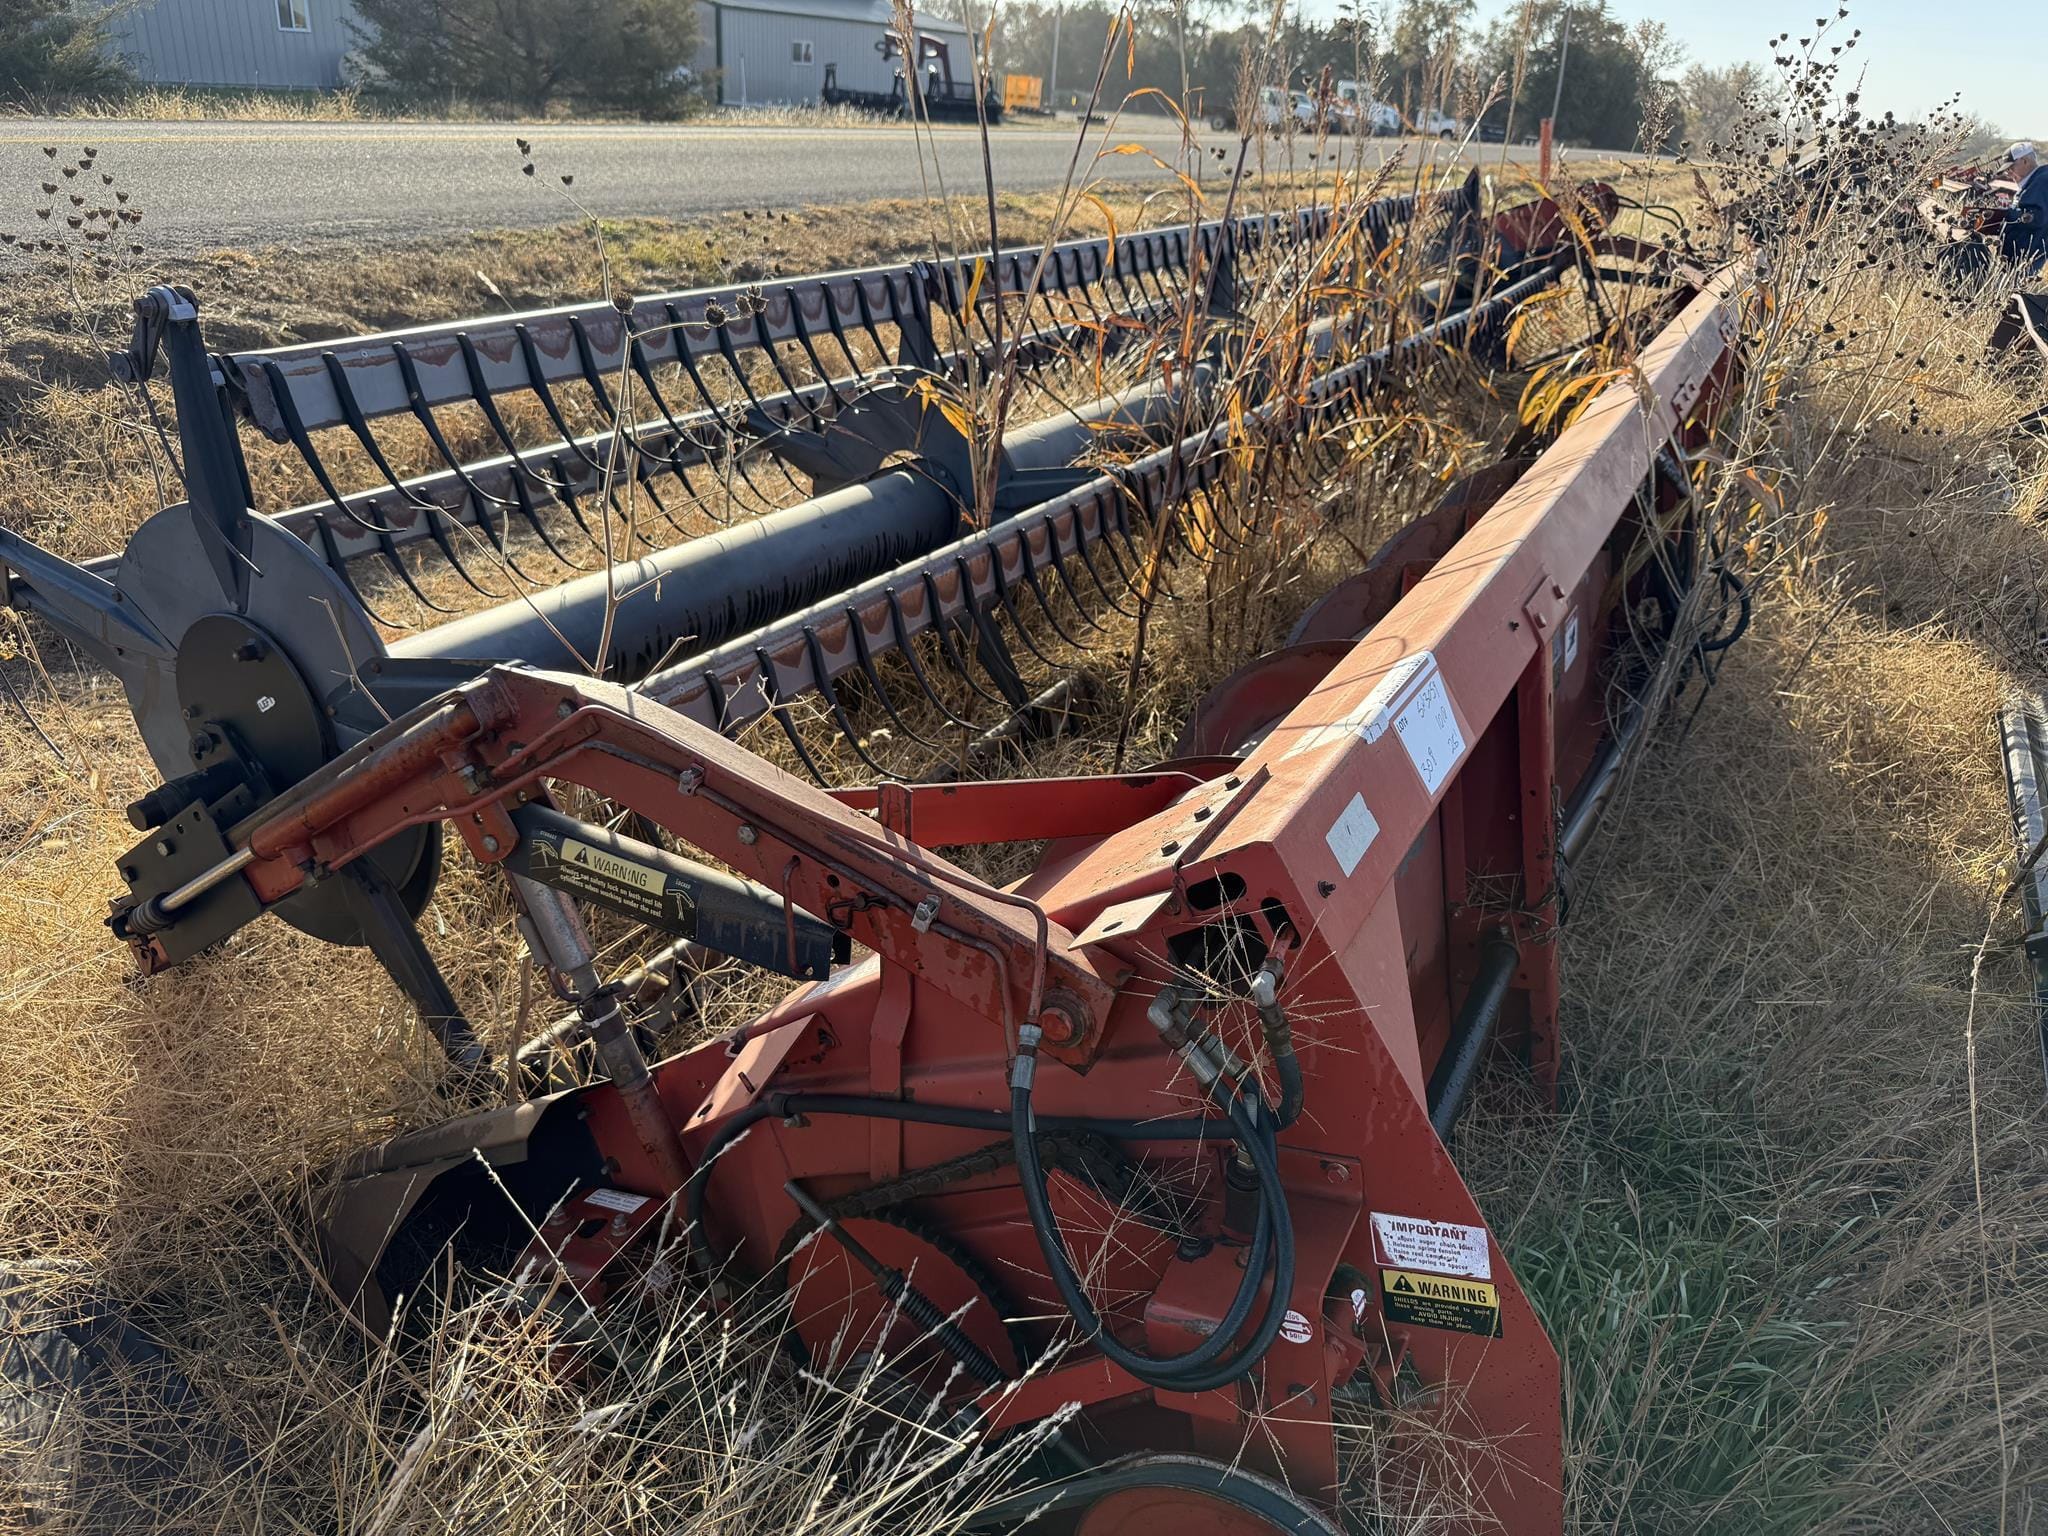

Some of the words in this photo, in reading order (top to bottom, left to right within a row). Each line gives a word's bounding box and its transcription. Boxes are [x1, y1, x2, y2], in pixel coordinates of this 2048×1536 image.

[1396, 716, 1409, 733] LOT#
[593, 855, 648, 887] WARNING
[628, 890, 641, 901] both
[1391, 1221, 1468, 1241] IMPORTANT
[1393, 1295, 1419, 1306] SHIELDS
[1417, 1281, 1487, 1303] WARNING
